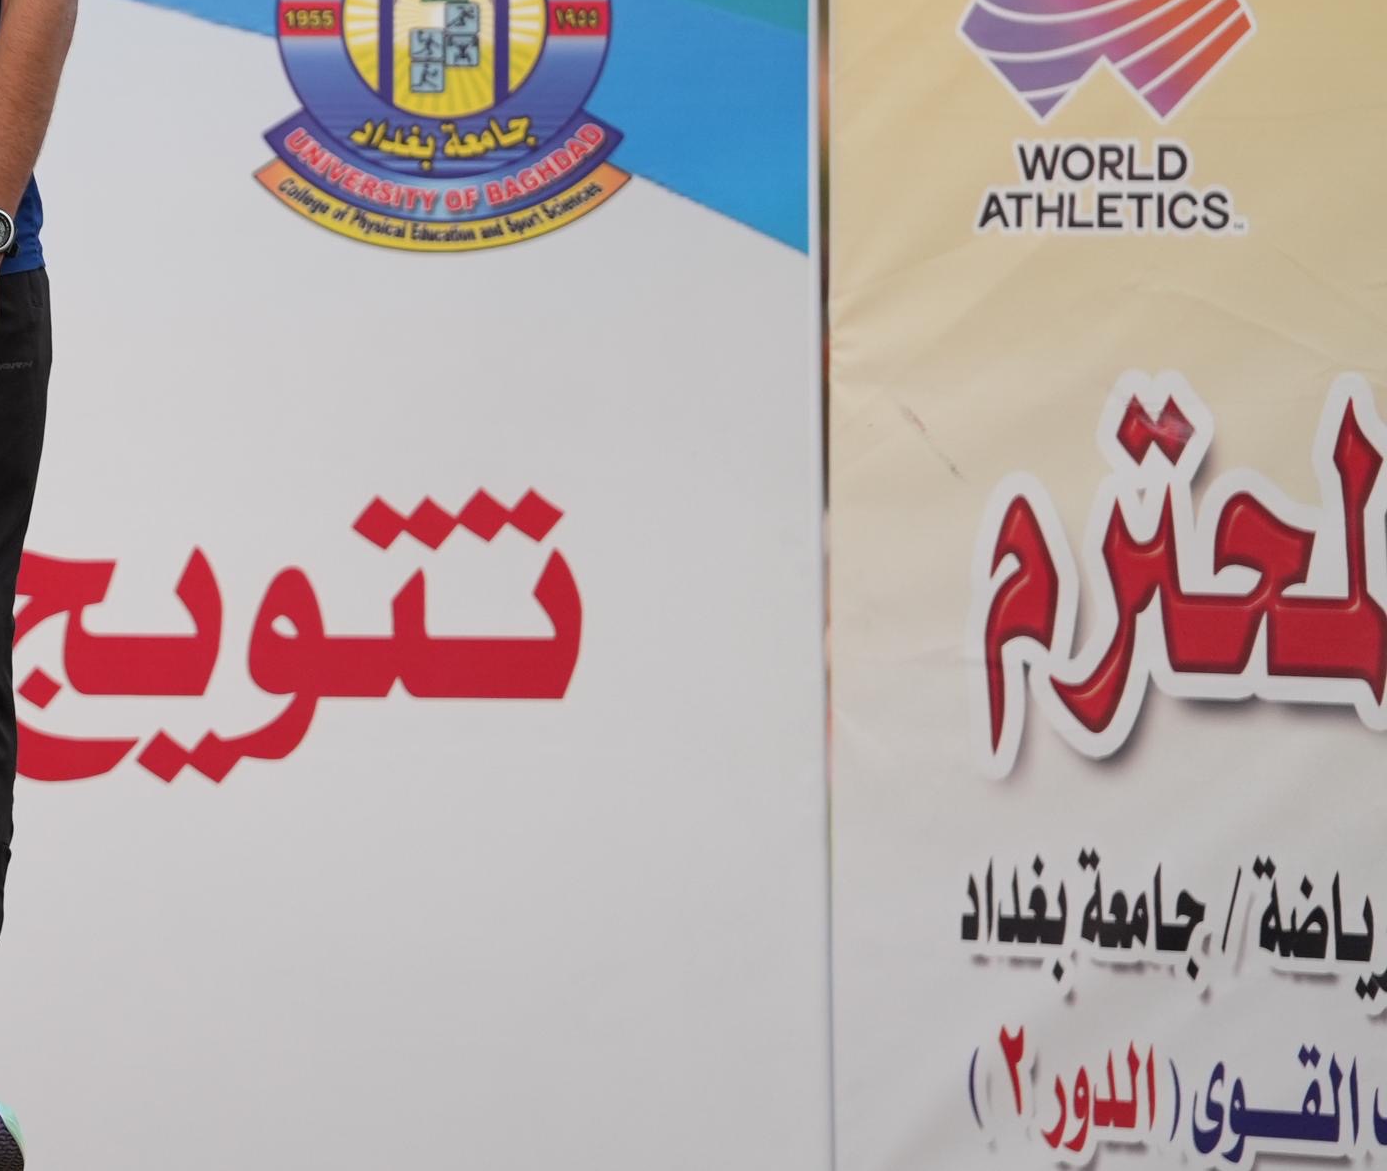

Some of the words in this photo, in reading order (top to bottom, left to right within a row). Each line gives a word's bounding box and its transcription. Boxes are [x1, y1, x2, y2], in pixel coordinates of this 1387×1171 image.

[283, 8, 335, 27] 1955
[283, 127, 439, 212] UNIVERSITY
[444, 188, 479, 212] OF
[484, 123, 606, 206] BAGHDAD
[348, 118, 436, 171] بغداد
[440, 116, 538, 159] جامعة
[1017, 144, 1189, 182] WORLD
[279, 178, 330, 215] College
[332, 205, 349, 221] of
[349, 210, 406, 238] Physical
[411, 221, 476, 242] Education
[481, 219, 504, 239] and
[505, 212, 543, 236] Sport
[977, 191, 1231, 231] ATHLETICS
[984, 393, 1387, 757] لمحترم
[960, 852, 1068, 983] بغداد
[1077, 846, 1207, 981] جامعة
[1192, 1043, 1359, 1164] القوى
